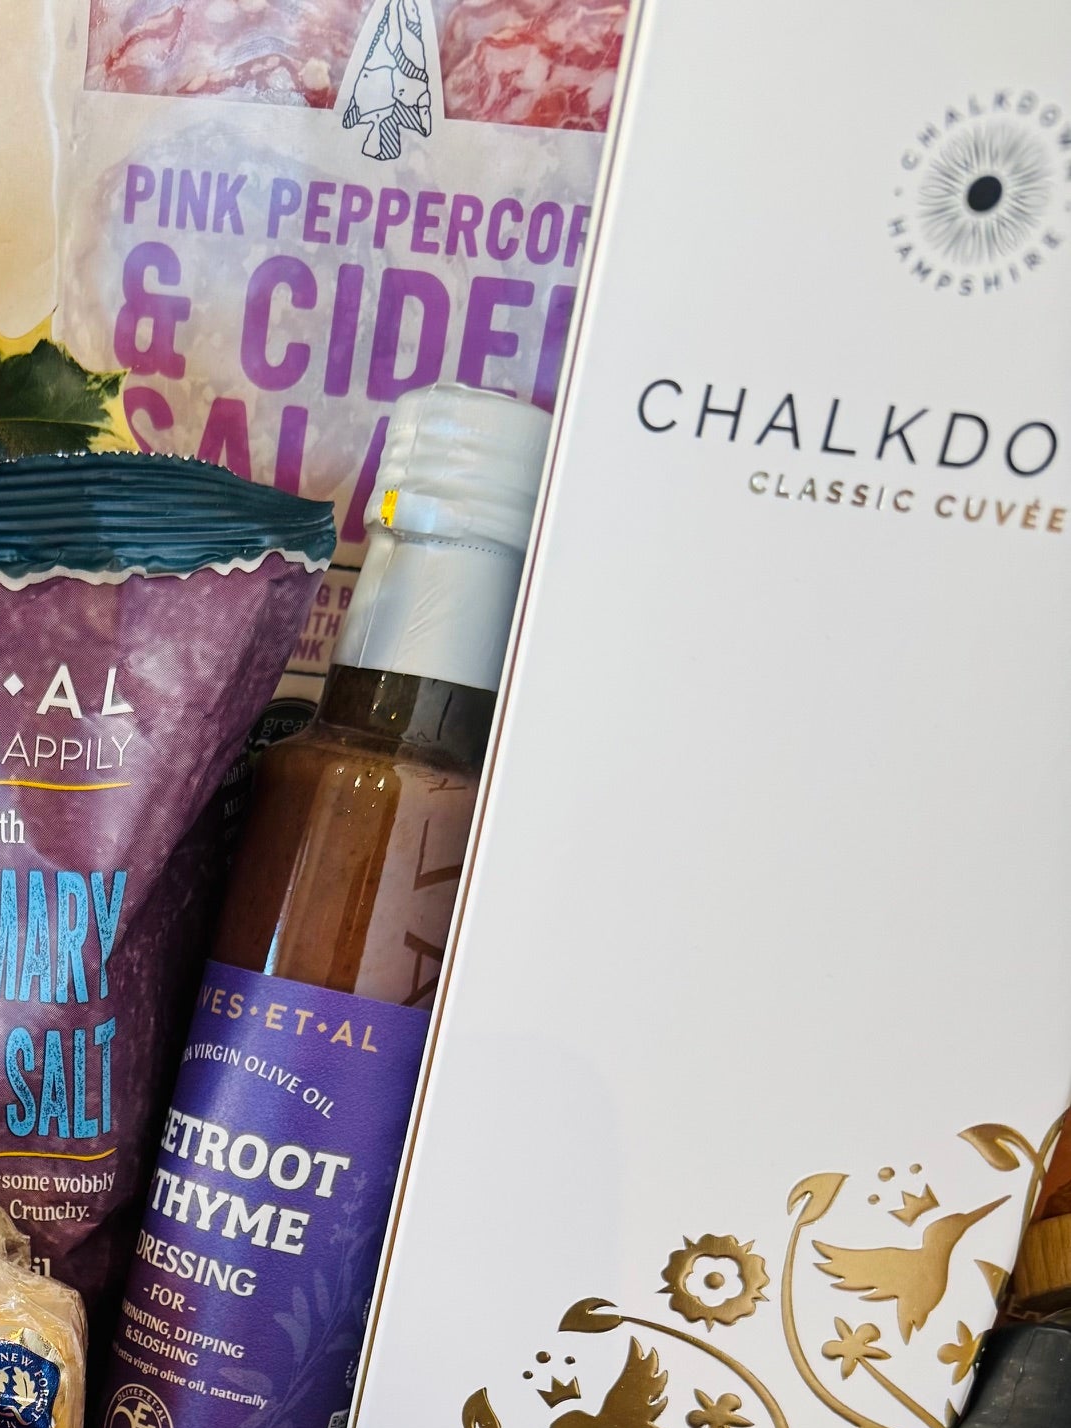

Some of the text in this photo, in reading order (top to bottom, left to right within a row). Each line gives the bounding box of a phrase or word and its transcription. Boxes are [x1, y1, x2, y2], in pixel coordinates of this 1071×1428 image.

[123, 165, 248, 235] PINK
[888, 218, 1060, 297] HAMPSHIRE
[114, 242, 191, 380] &
[637, 379, 1058, 478] CHALKDO
[749, 471, 1067, 534] CLASSIC CUVÉE
[6, 1017, 116, 1141] SALT
[194, 1043, 242, 1066] VIRGIN
[244, 1056, 302, 1094] OLIVE
[303, 1087, 335, 1119] OIL
[53, 1172, 115, 1194] wobbly
[160, 1107, 351, 1198] ETROOT
[10, 1200, 90, 1222] Crunchy.
[151, 1167, 311, 1256] THYME
[136, 1229, 257, 1297] DRESSING
[174, 1326, 245, 1359] DIPPING
[0, 1352, 33, 1366] NEW
[31, 1369, 49, 1421] FOREST
[133, 1357, 159, 1374] virgin
[160, 1369, 187, 1386] olive
[187, 1380, 208, 1395] oil,
[210, 1385, 268, 1410] naturally
